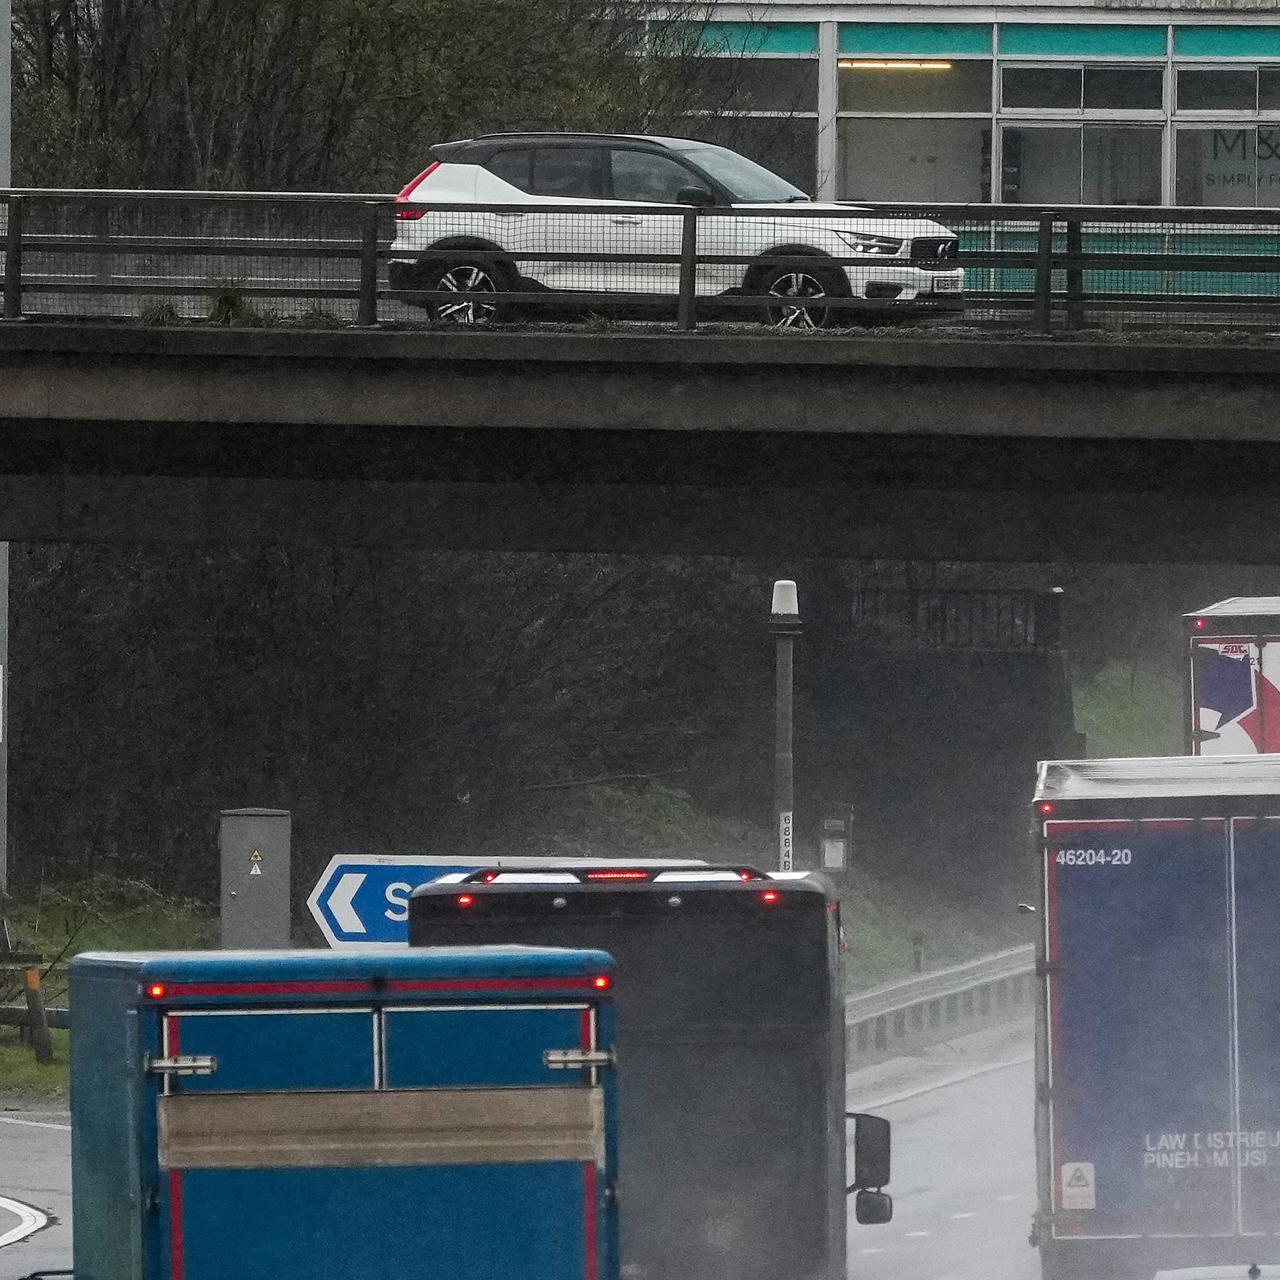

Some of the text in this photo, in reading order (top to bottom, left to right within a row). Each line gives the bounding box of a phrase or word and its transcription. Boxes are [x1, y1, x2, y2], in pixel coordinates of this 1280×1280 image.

[783, 815, 792, 871] 6884B
[1055, 848, 1132, 866] 46204-20
[1144, 1132, 1187, 1151] LAW
